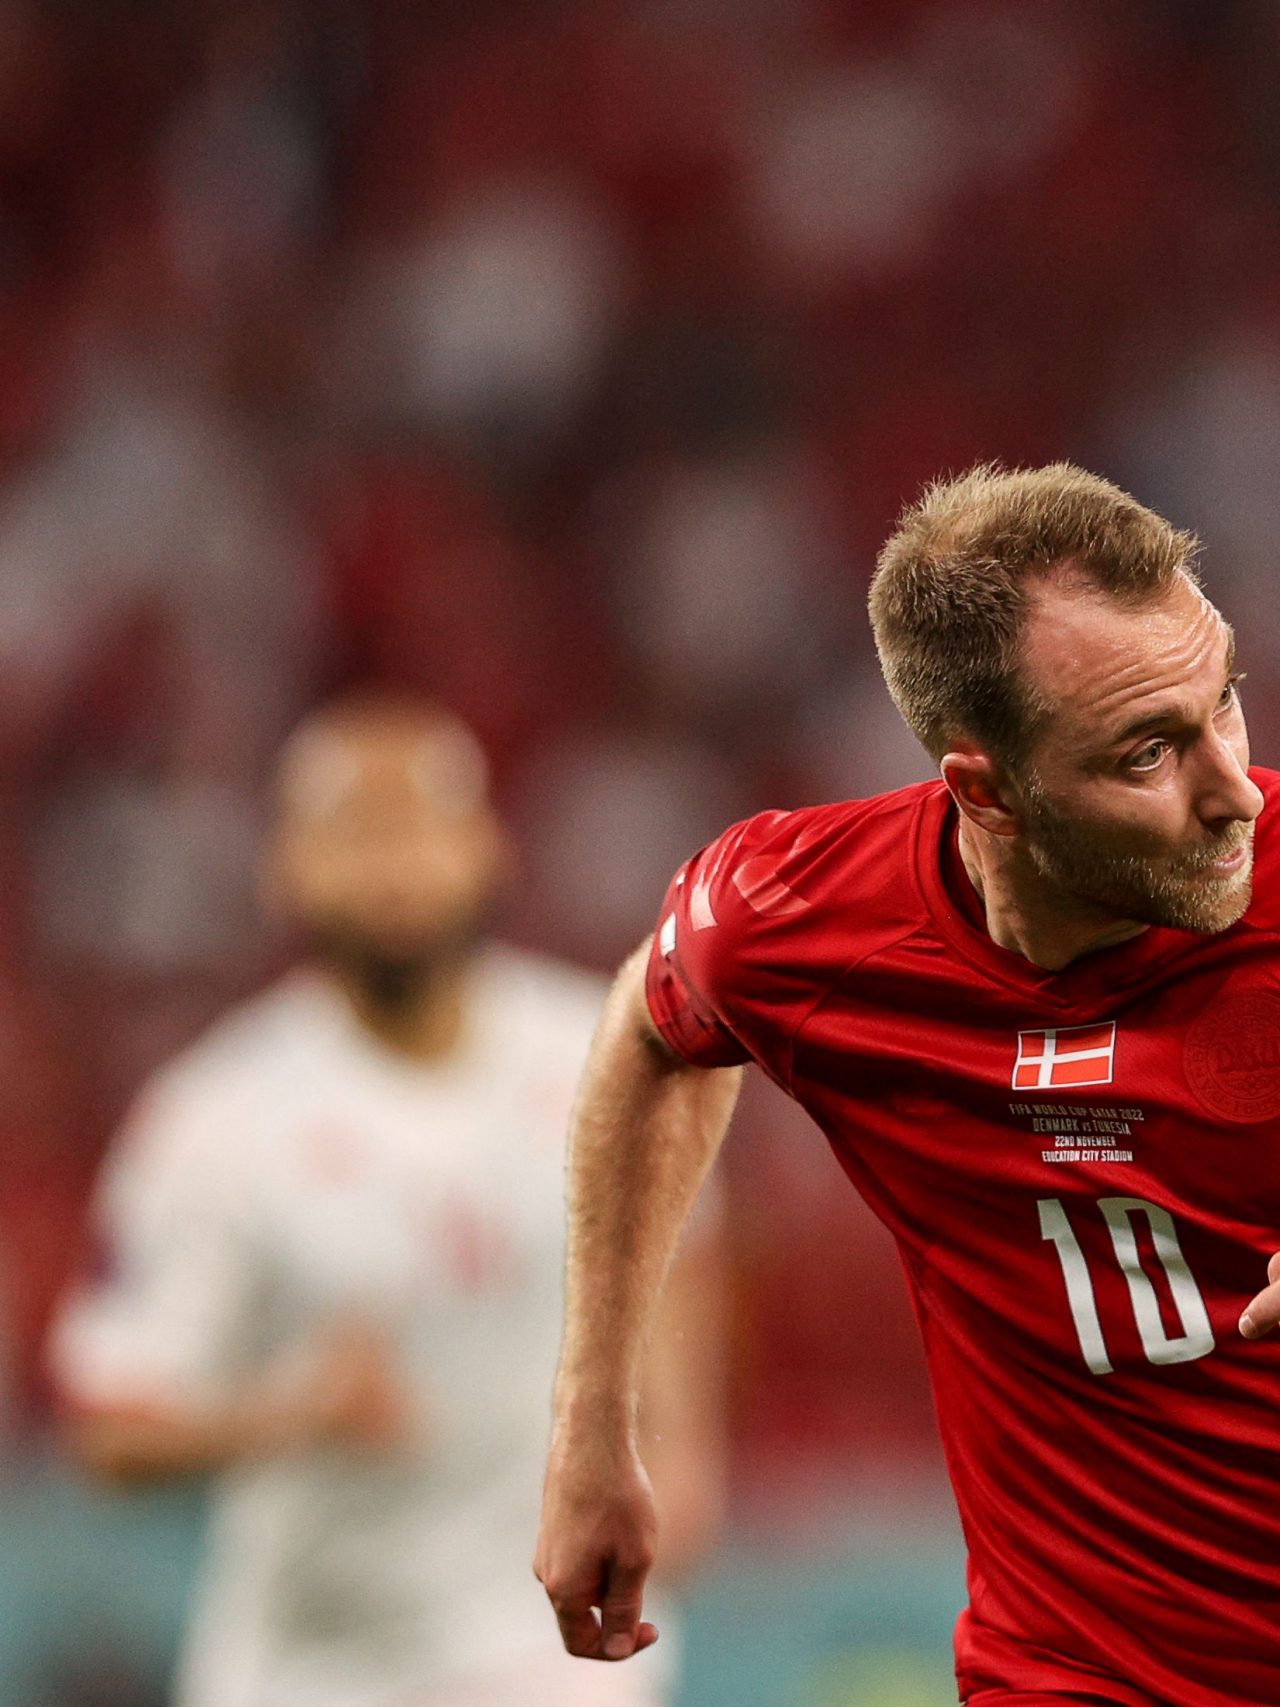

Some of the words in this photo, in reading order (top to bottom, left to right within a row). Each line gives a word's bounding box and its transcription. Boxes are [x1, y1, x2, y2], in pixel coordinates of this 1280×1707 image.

[1009, 1103, 1031, 1115] FIFA
[1032, 1104, 1068, 1116] WORLD
[1068, 1106, 1087, 1117] CUP
[1089, 1107, 1118, 1119] QATAR
[1119, 1108, 1145, 1121] 2022
[1033, 1117, 1080, 1132] DENMARK
[1055, 1135, 1075, 1147] 22ND
[1076, 1135, 1116, 1147] NOVEMBER
[1041, 1150, 1080, 1163] EDUCATION
[1082, 1150, 1099, 1162] CITY
[1101, 1150, 1134, 1162] STADIUM
[1037, 1197, 1215, 1375] 10
